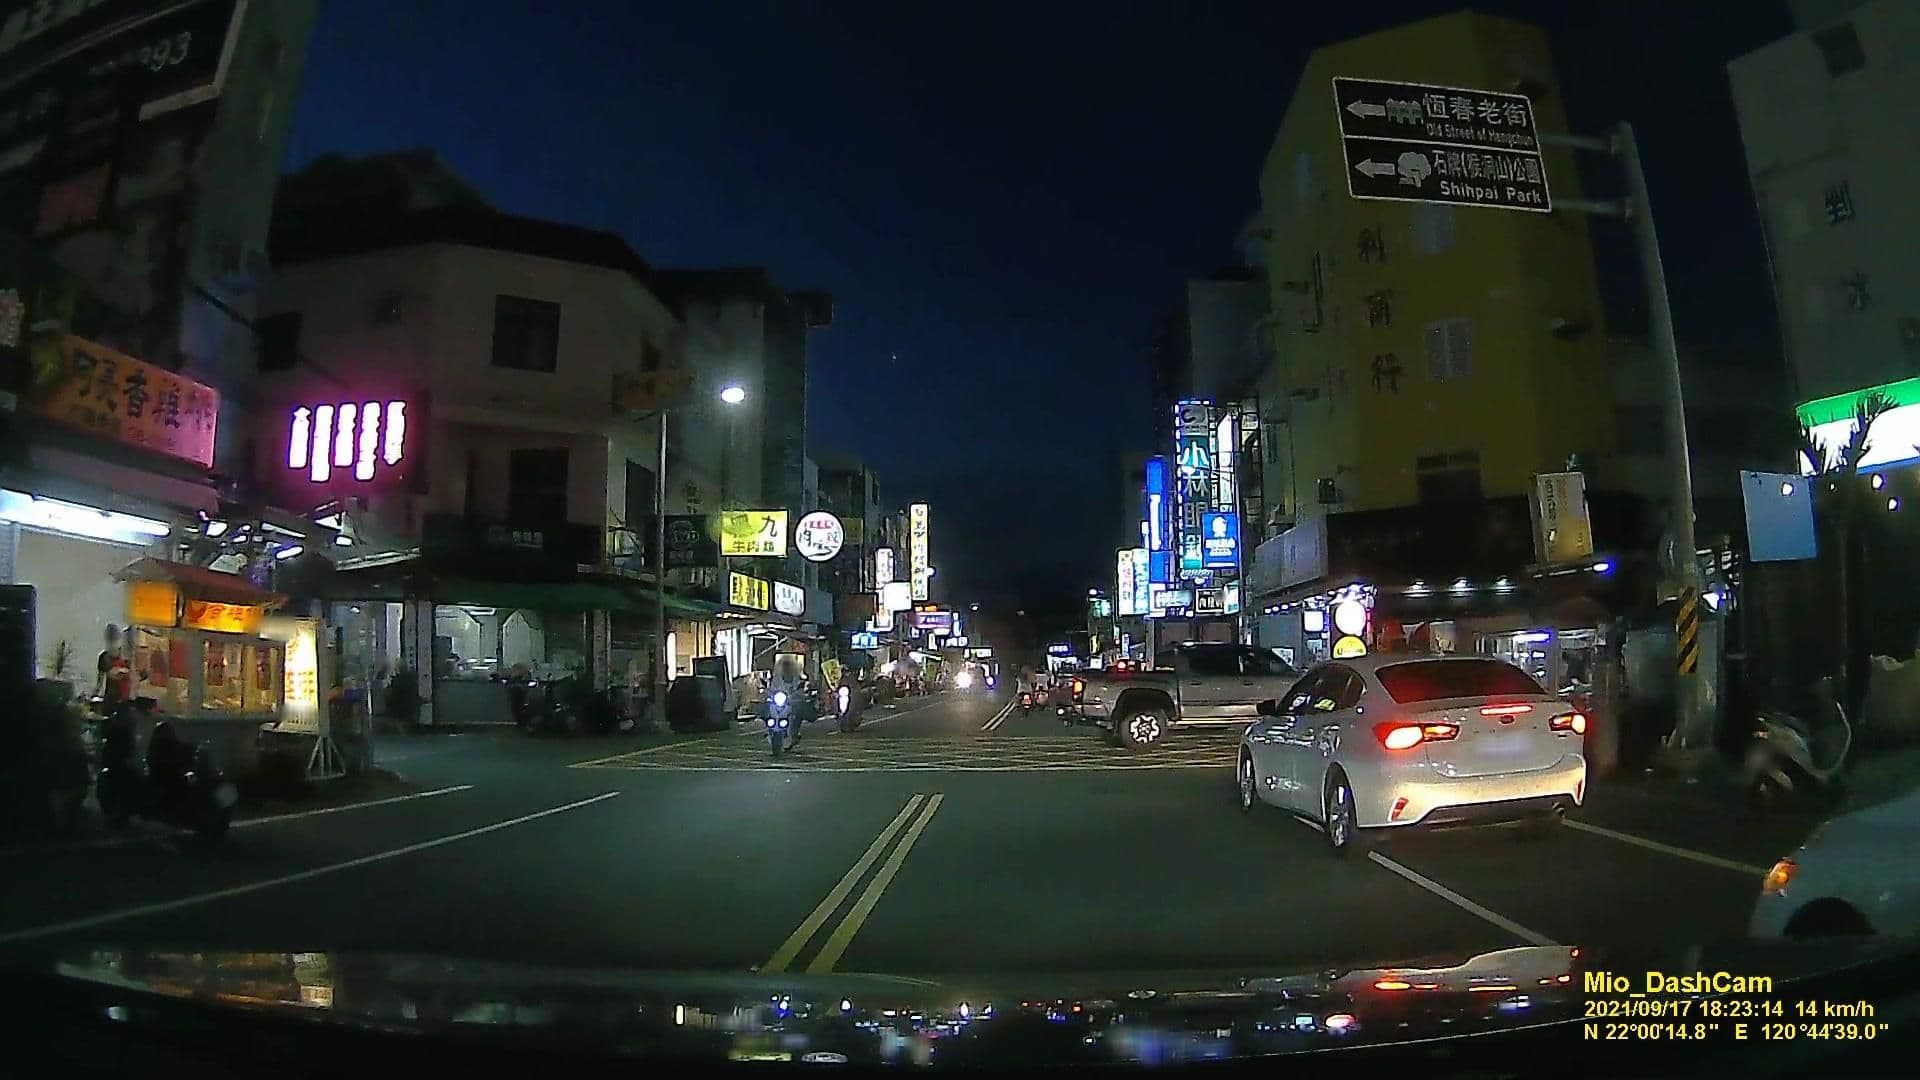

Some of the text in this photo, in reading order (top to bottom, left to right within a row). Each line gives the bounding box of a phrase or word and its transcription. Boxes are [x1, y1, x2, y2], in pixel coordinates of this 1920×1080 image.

[1422, 92, 1527, 128] 恆春老街
[1426, 122, 1443, 137] Old
[1444, 124, 1475, 140] Street
[1477, 127, 1488, 141] of
[1440, 180, 1542, 204] Shihpai Park
